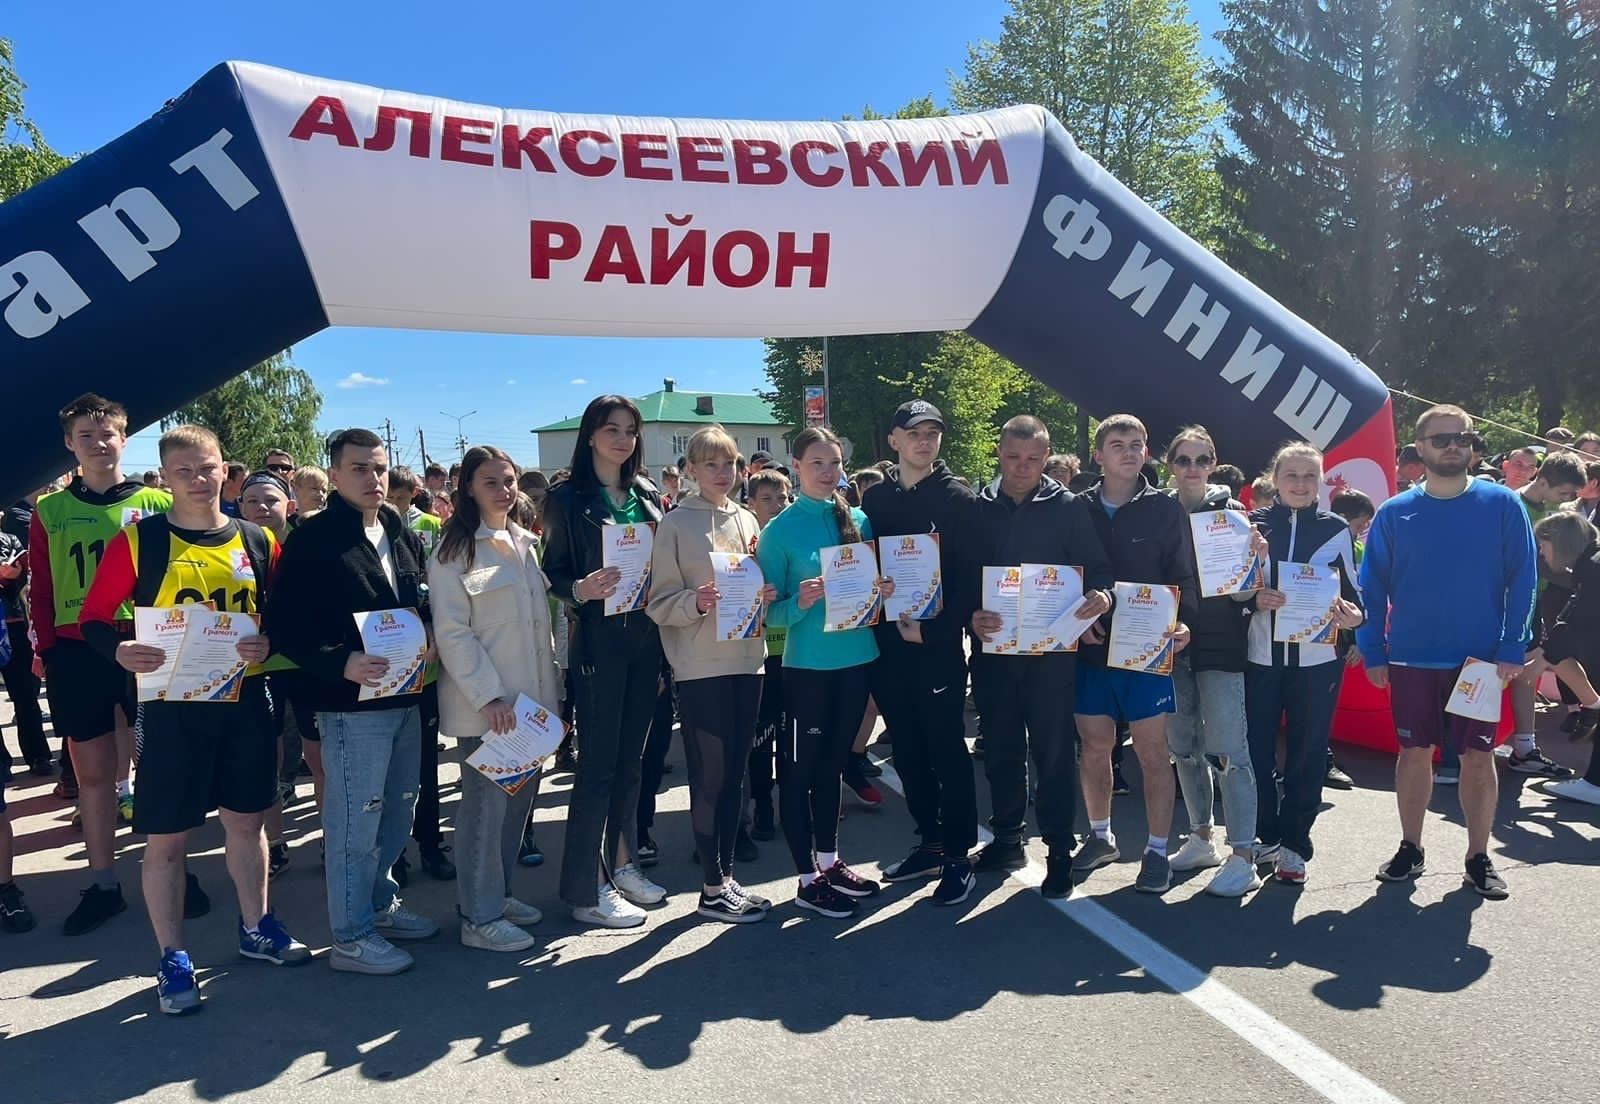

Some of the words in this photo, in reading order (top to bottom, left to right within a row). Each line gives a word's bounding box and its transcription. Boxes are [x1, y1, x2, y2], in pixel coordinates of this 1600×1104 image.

[288, 95, 1009, 188] АЛЕКСЕЕВСКИЙ
[530, 213, 831, 289] РАЙОН
[1043, 194, 1352, 451] ФИНИШ
[202, 627, 239, 637] Грамота
[1127, 596, 1158, 607] Грамота
